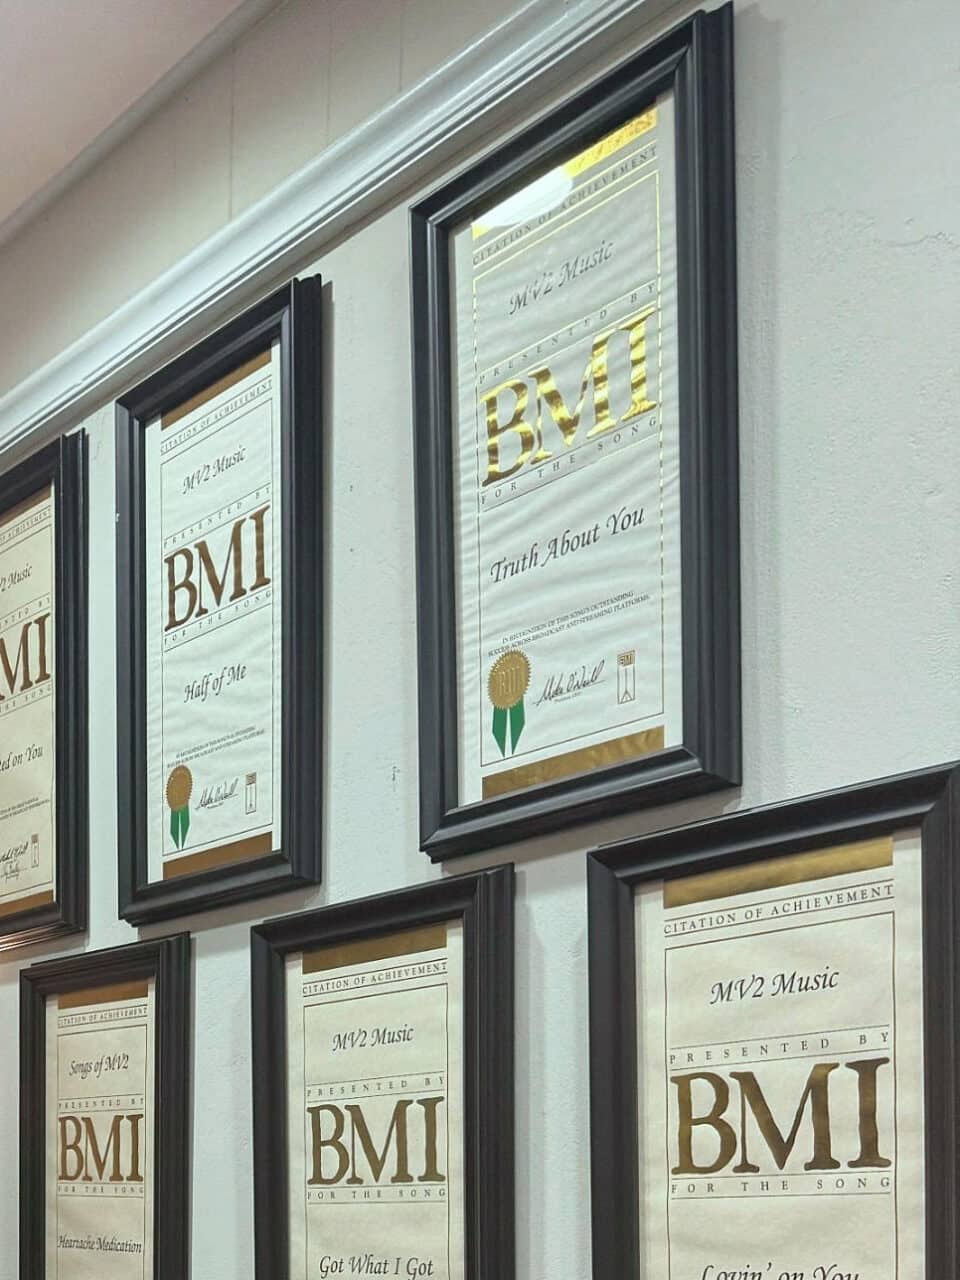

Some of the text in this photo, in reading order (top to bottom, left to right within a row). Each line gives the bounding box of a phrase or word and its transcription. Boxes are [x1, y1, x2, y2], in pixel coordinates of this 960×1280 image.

[472, 146, 658, 266] CITATION OF ACHIEVEMENT
[558, 239, 614, 278] Music
[479, 282, 656, 385] PRESENTED BY
[213, 379, 273, 424] ACHIEVEMENT
[481, 307, 657, 487] BMI
[182, 445, 247, 495] MV2 Music
[480, 416, 658, 504] FOR THE SONG
[164, 502, 242, 548] PRESENTED
[490, 507, 644, 583] Truth About You
[7, 563, 32, 590] Music
[164, 505, 270, 631] BMI
[184, 663, 247, 703] Half of Me
[12, 752, 23, 769] on
[24, 744, 43, 763] You
[664, 884, 894, 936] CITATION OF ACHIEVEMENT
[302, 961, 447, 995] CITATION OF ACHIEVEMENT
[709, 965, 840, 1005] MV2 Music
[332, 1024, 414, 1051] MV2 Music
[669, 1031, 890, 1065] PRESENTED BY
[69, 1054, 129, 1080] Songs of MV2
[307, 1076, 444, 1097] PRESENTED BY
[671, 1057, 892, 1175] BMI
[58, 1114, 144, 1182] BMI
[307, 1096, 446, 1185] BMI
[307, 1188, 446, 1200] FOR THE SONG
[671, 1177, 891, 1195] FOR THE SONG
[319, 1255, 344, 1279] Got
[348, 1254, 389, 1275] What
[393, 1257, 403, 1275] I
